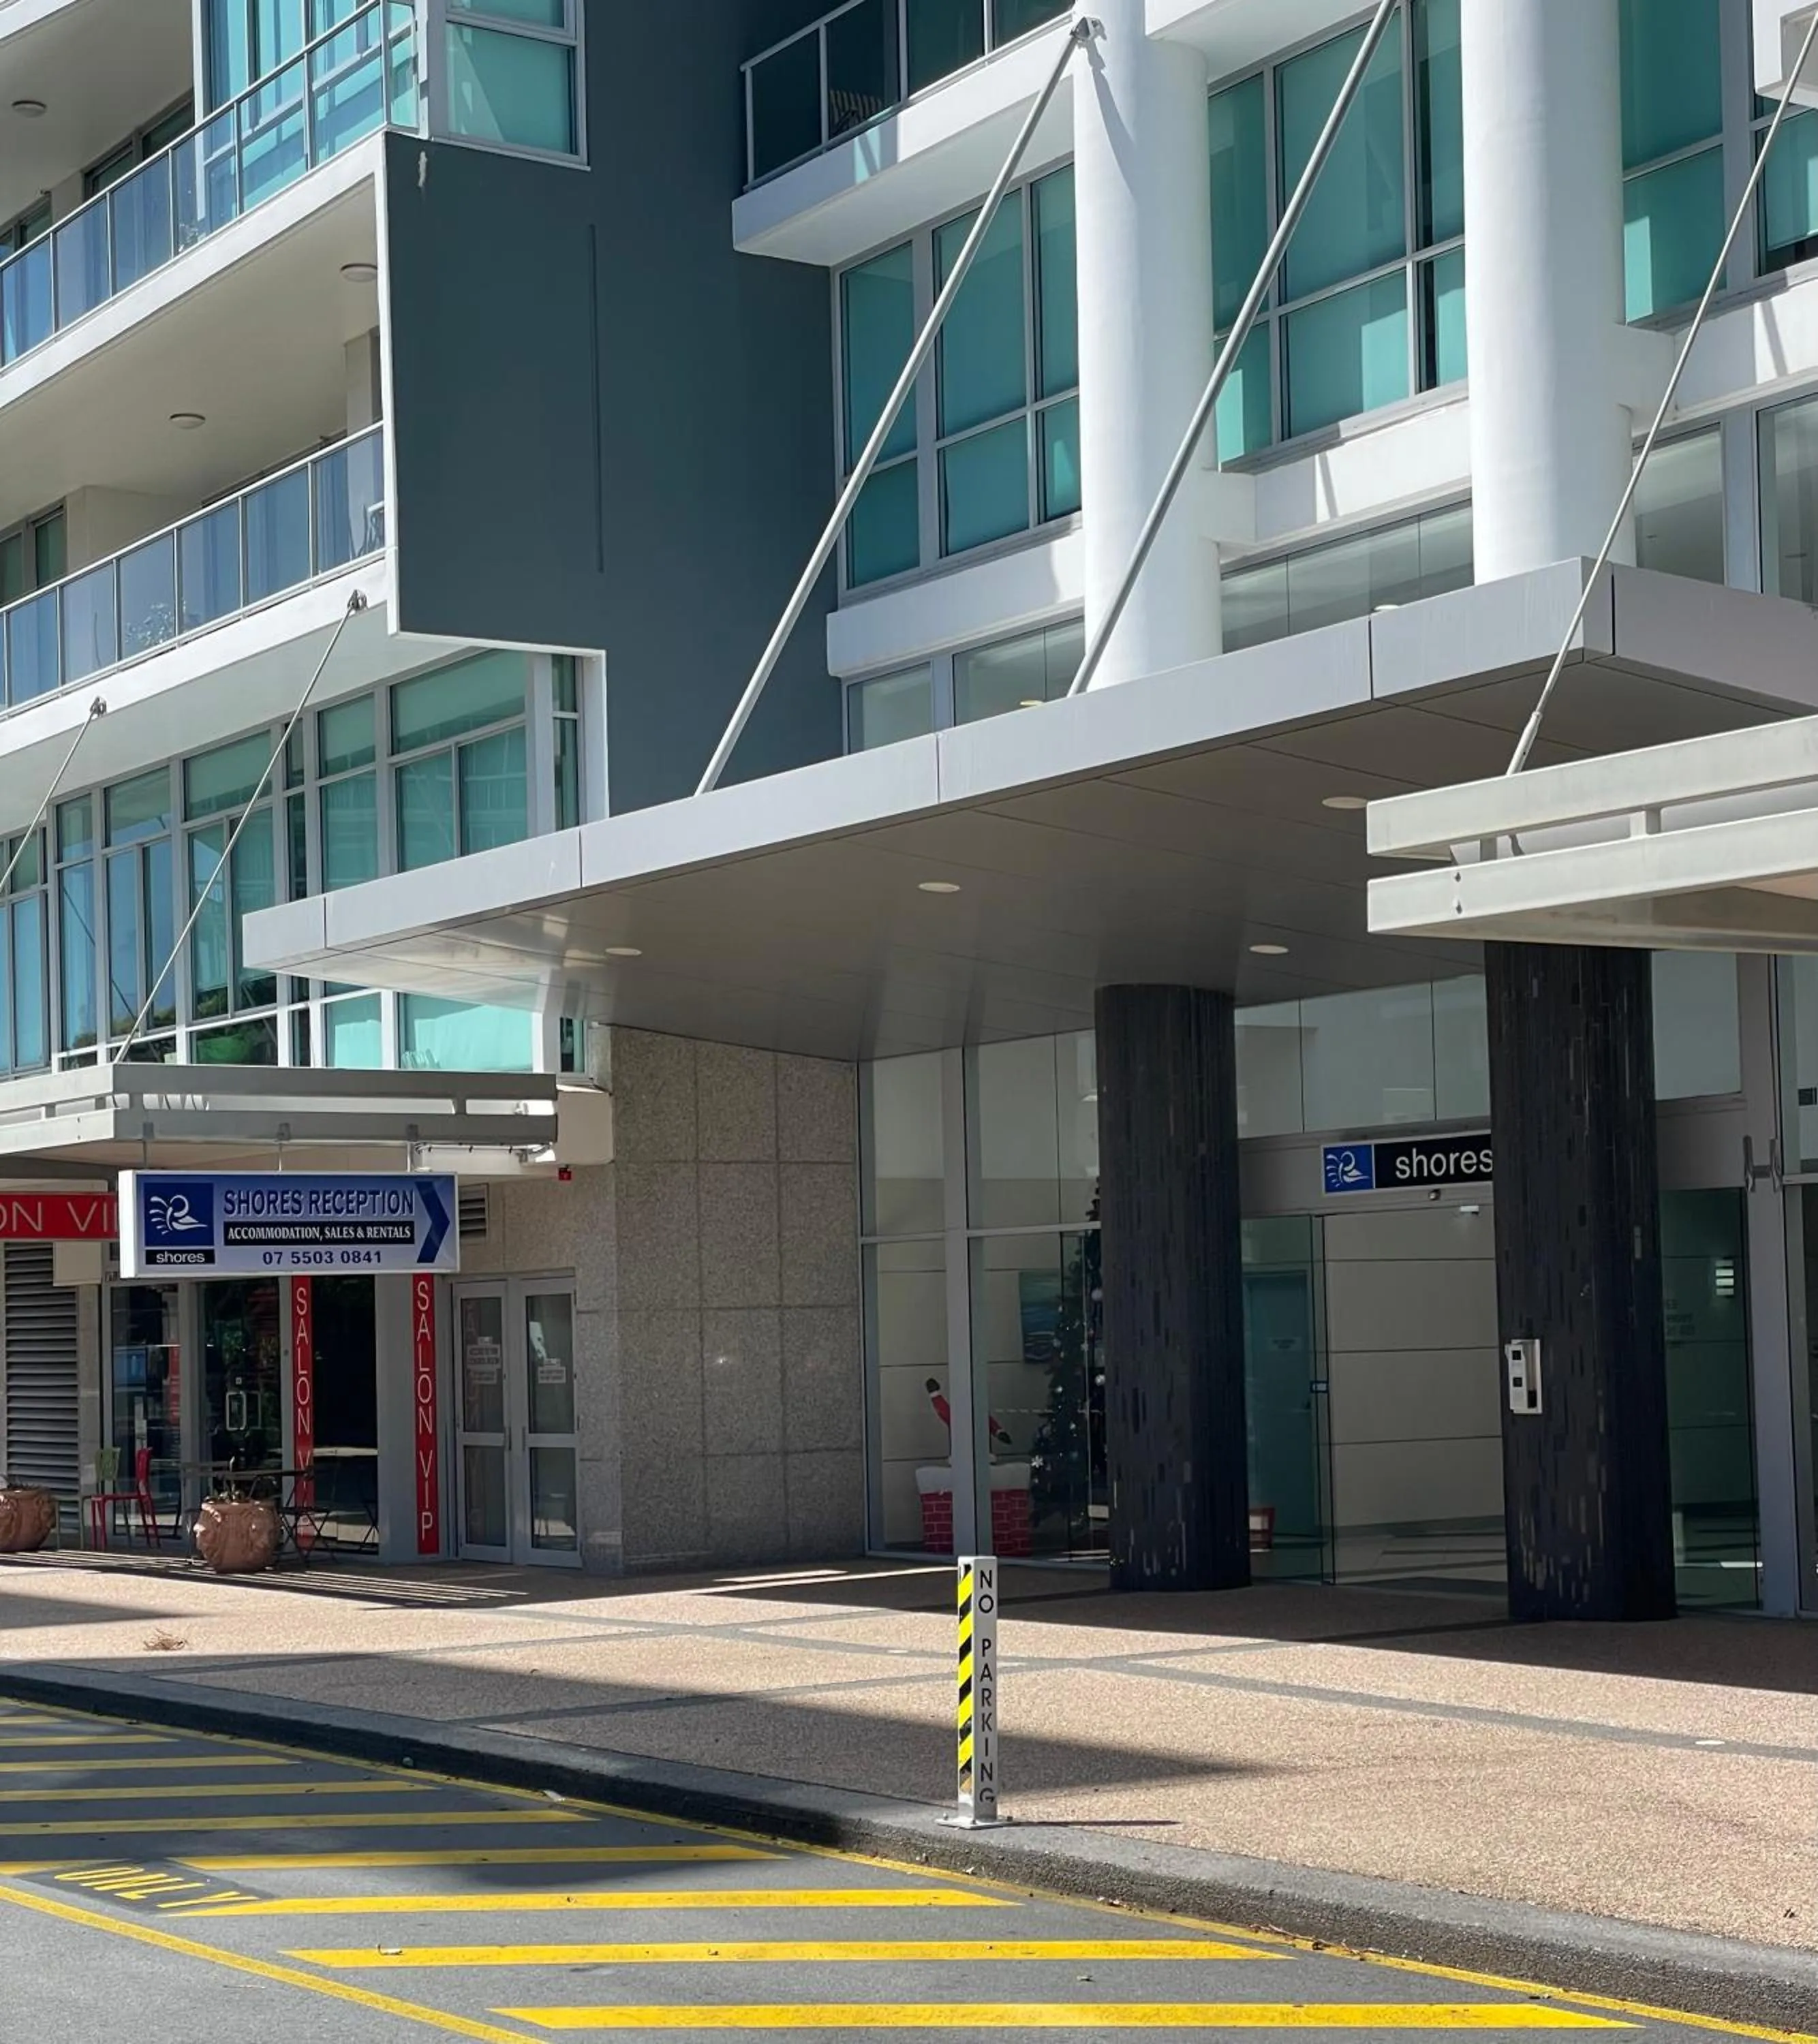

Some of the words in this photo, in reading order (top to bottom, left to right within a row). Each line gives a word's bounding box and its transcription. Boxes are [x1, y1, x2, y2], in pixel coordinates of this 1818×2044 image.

[1396, 1147, 1493, 1179] shores
[67, 1201, 119, 1232] VI
[224, 1190, 304, 1215] SHORES
[309, 1190, 415, 1215] RECEPTION
[228, 1227, 322, 1241] ACCOMMODATION,
[325, 1227, 354, 1239] SALES
[356, 1227, 365, 1239] &
[367, 1226, 411, 1239] RENTALS
[156, 1251, 205, 1263] shores
[263, 1252, 283, 1265] 07
[291, 1251, 333, 1264] 5503
[341, 1250, 382, 1263] 0841
[296, 1287, 310, 1434] SALON
[417, 1281, 432, 1434] SALON
[419, 1450, 433, 1540] VIP
[979, 1569, 994, 1614] NO
[979, 1639, 996, 1803] PARKING
